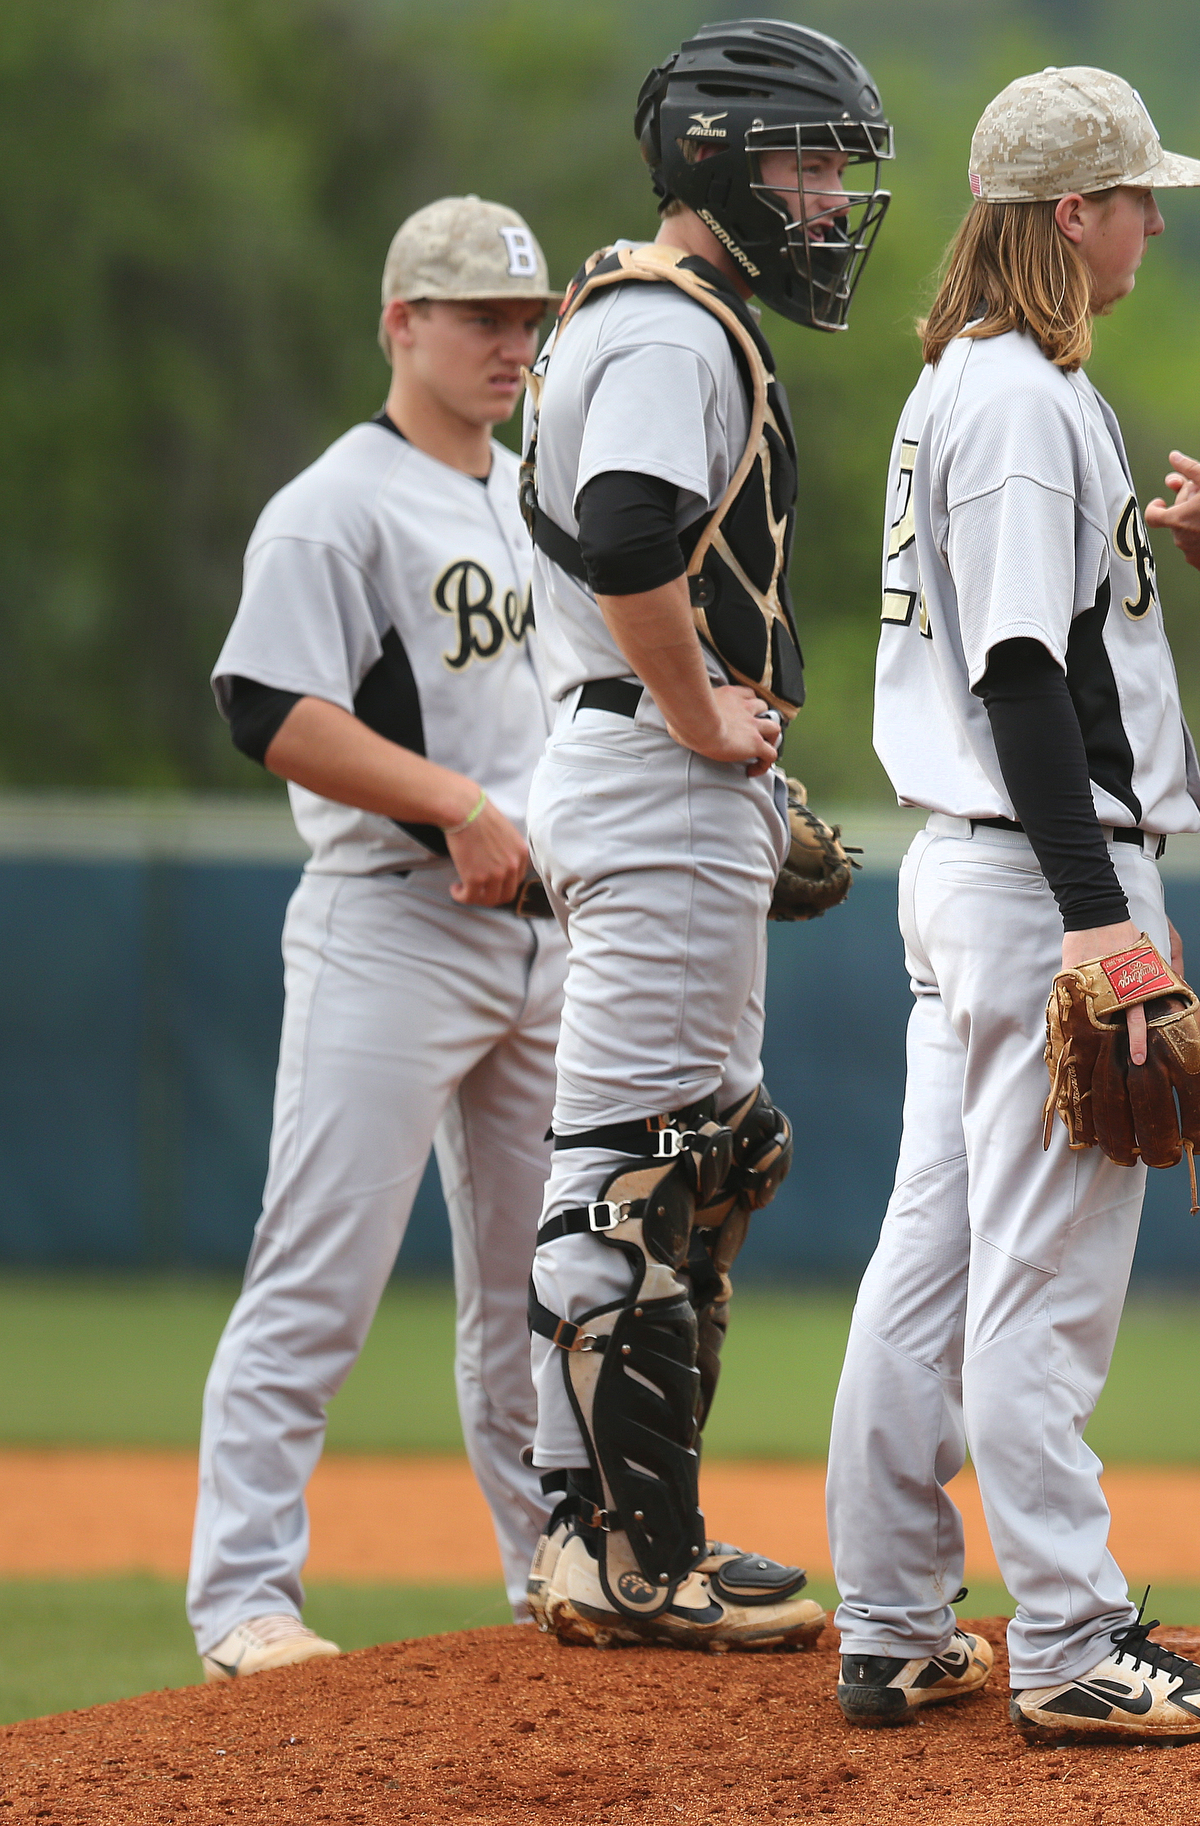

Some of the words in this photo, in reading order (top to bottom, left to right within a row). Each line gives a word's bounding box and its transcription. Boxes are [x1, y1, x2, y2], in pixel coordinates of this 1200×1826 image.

[500, 226, 539, 278] B
[697, 209, 761, 278] SAMURAI
[1117, 960, 1160, 989] Rawlings
